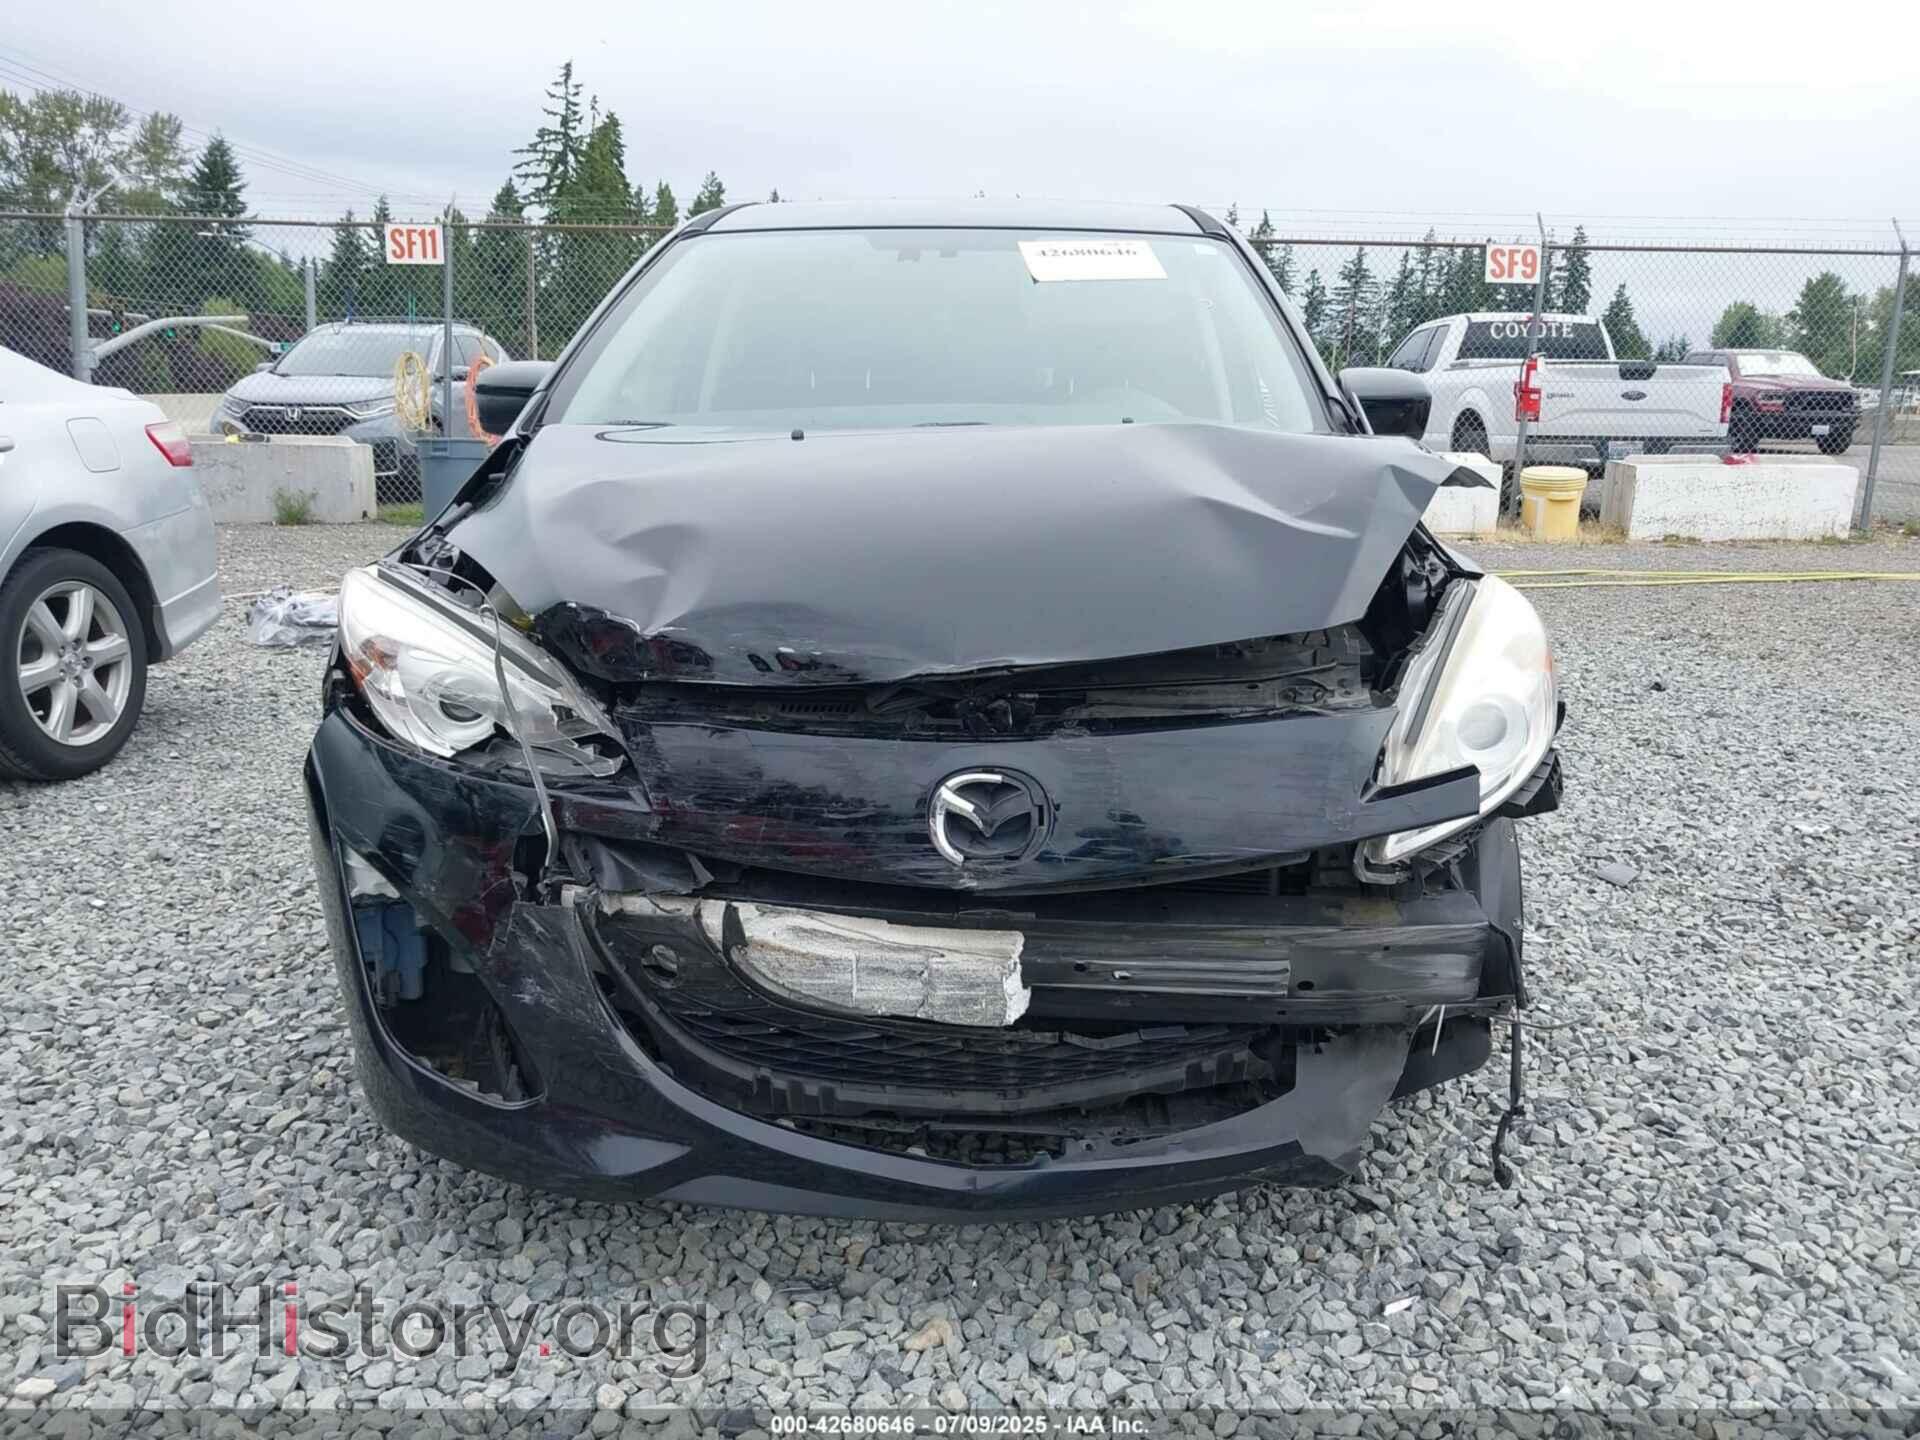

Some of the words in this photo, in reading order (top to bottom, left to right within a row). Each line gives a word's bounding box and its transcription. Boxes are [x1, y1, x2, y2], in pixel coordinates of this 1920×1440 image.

[390, 228, 437, 259] SF11
[1490, 248, 1538, 279] SF9
[1490, 321, 1574, 339] COYOTE
